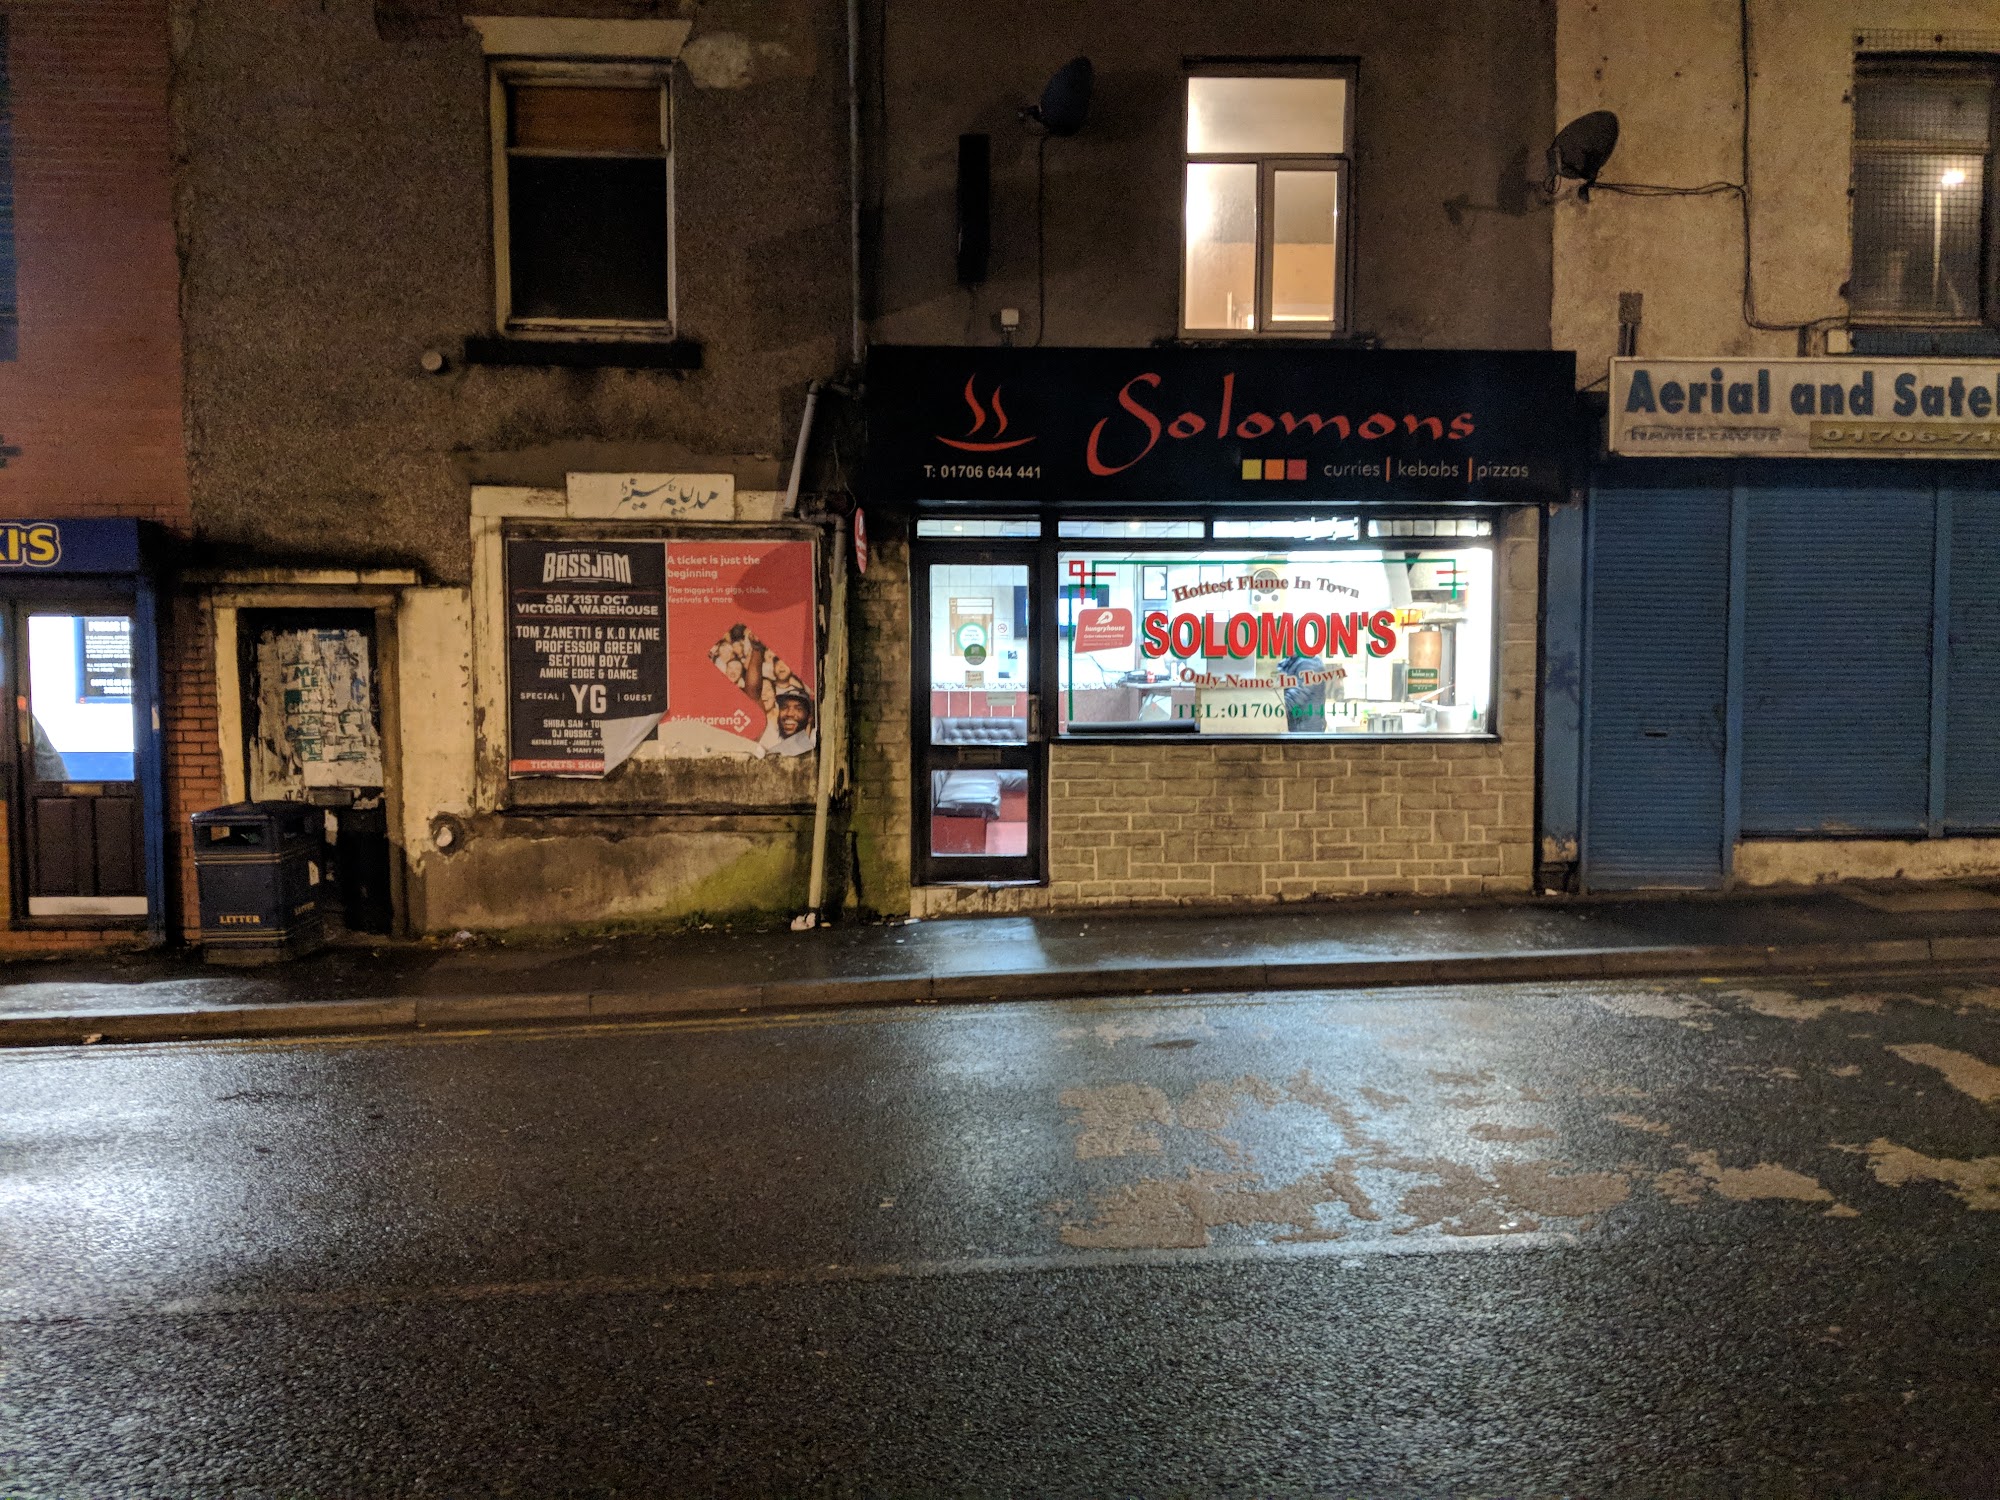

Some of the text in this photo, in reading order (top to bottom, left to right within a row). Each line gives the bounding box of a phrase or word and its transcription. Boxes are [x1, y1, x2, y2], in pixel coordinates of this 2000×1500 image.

[1625, 367, 2000, 418] Aerial and Sate
[1086, 372, 1475, 476] Solomons
[924, 465, 1042, 479] T: 01706 644 441
[1323, 459, 1529, 480] curries kebabs pizzas
[666, 555, 761, 567] A ticket is just the
[542, 552, 632, 585] BASSJAM
[667, 568, 718, 580] beginning
[684, 586, 714, 595] biggest
[1172, 575, 1360, 602] Hottest Flame In Town
[546, 594, 629, 605] SAT 21ST OCT
[516, 603, 659, 616] VICTORIA WAREHOUSE
[516, 625, 540, 639] TOM
[543, 626, 591, 640] ZANETTI
[594, 626, 603, 640] &
[629, 627, 660, 641] KANE
[1084, 624, 1125, 633] hungryhouse
[1140, 611, 1397, 660] SOLOMON'S
[535, 640, 642, 655] PROFESSOR GREEN
[548, 654, 629, 668] SECTION BOYZ
[539, 667, 569, 679] AMINE
[571, 668, 595, 680] EDGE
[607, 668, 638, 680] DANCE
[1279, 674, 1296, 688] In
[1300, 667, 1348, 686] Town
[520, 684, 653, 714] SPECIAL YG GUEST
[543, 718, 566, 729] SHIBA
[567, 719, 584, 729] SAN
[551, 729, 593, 739] DJ RUSSKE
[219, 914, 261, 924] LITTER
